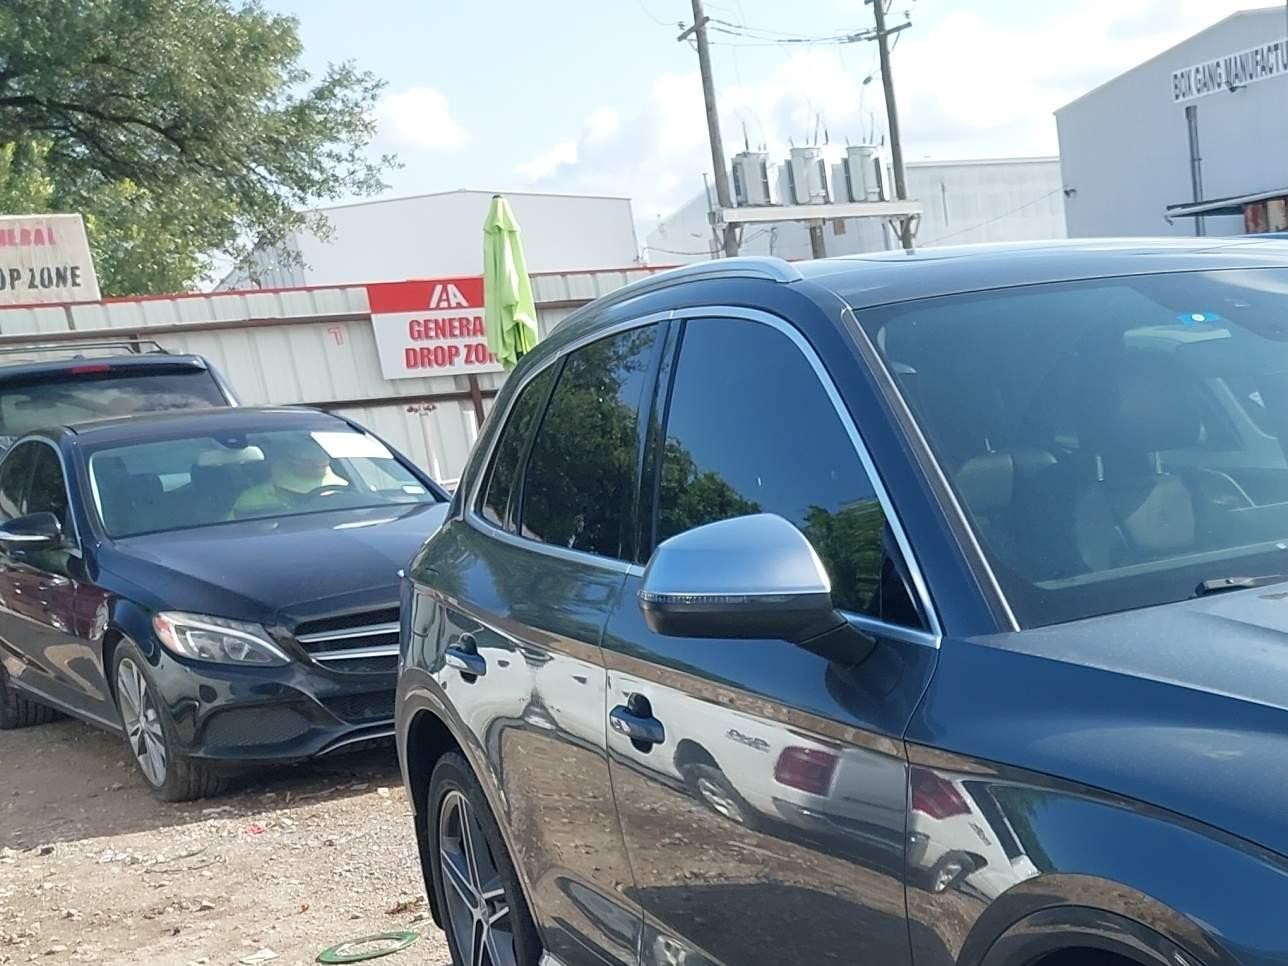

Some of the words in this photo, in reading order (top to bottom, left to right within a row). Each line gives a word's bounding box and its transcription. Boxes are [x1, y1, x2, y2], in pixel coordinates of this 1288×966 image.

[1173, 71, 1193, 100] BOX
[1194, 61, 1222, 94] GANG
[28, 265, 81, 289] ZONE
[408, 316, 485, 341] GENERA
[404, 345, 459, 369] DROP
